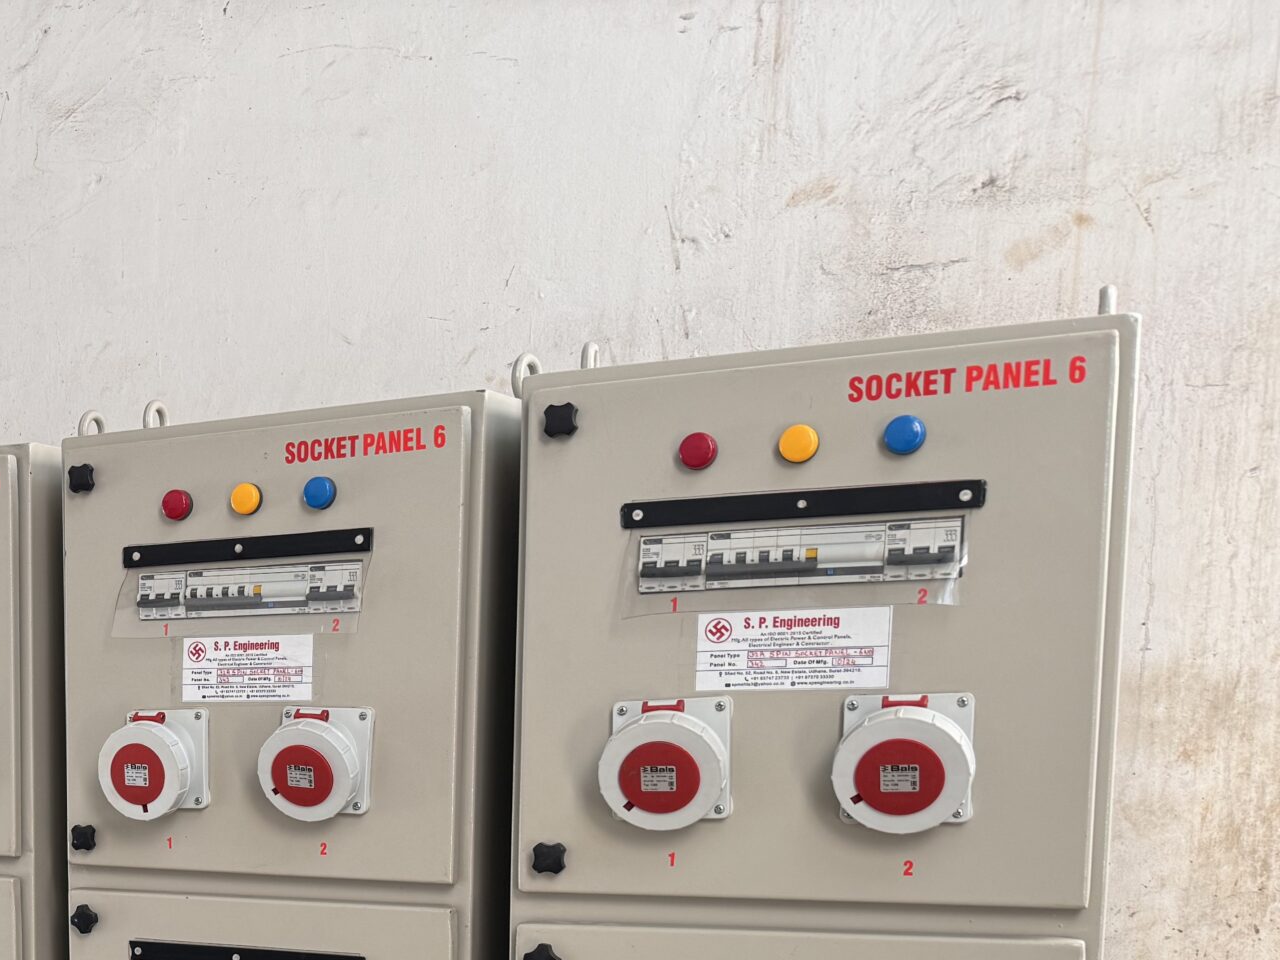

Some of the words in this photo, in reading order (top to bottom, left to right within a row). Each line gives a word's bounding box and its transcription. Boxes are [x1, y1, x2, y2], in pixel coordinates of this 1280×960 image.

[848, 368, 956, 402] SOCKET
[965, 358, 1057, 392] PANEL
[1070, 356, 1086, 384] 6
[285, 434, 359, 464] SOCKET
[363, 427, 426, 456] PANEL
[434, 425, 446, 447] 6
[670, 597, 678, 612] 1
[917, 588, 927, 605] 2
[162, 623, 169, 636] 1
[332, 618, 340, 632] 2
[743, 617, 754, 630] S.
[758, 617, 768, 628] P.
[772, 614, 840, 630] Engineering
[214, 641, 221, 651] S.
[224, 641, 231, 651] P.
[233, 640, 279, 652] Engineering
[167, 837, 172, 849] 1
[320, 842, 327, 855] 2
[668, 852, 675, 867] 1
[903, 860, 913, 876] 2
